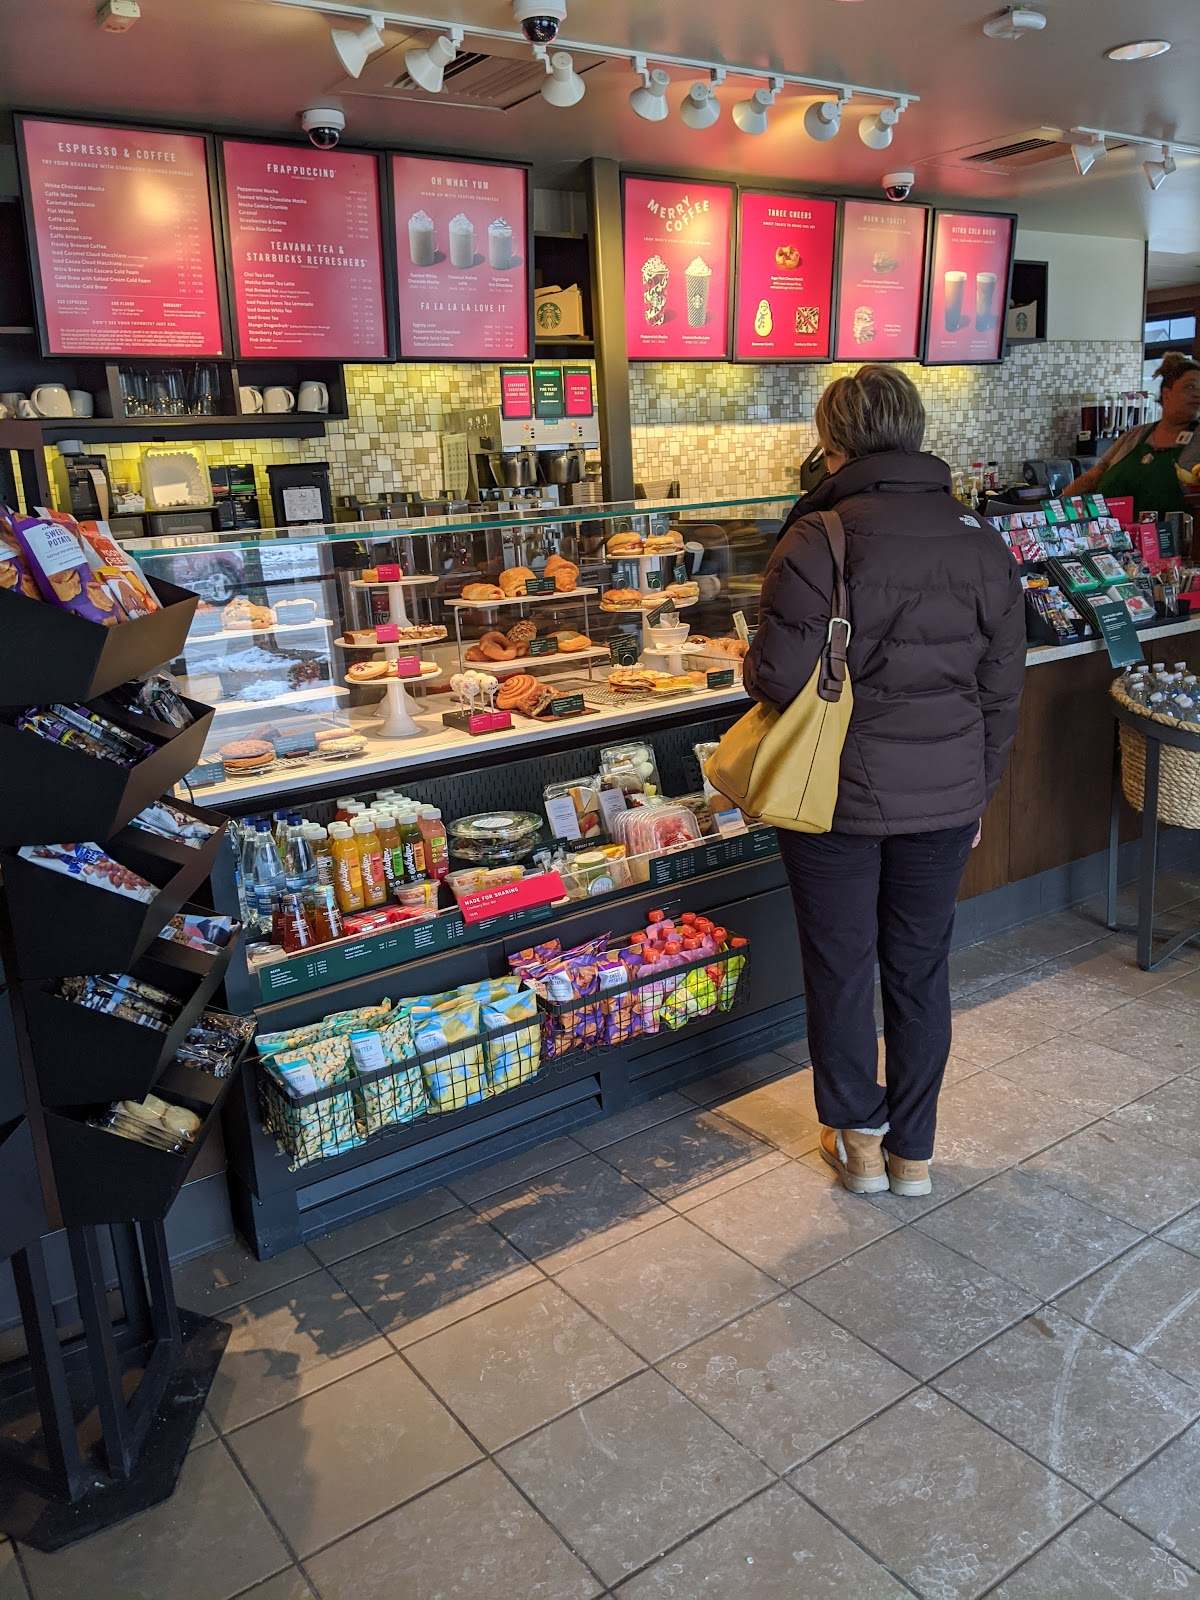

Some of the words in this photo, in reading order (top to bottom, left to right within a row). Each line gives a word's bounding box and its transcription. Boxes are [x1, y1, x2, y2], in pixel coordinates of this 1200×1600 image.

[58, 142, 117, 157] ESPRESSO
[123, 148, 130, 158] &
[136, 150, 177, 162] COFFEE
[267, 163, 336, 178] FRAPPUCCINO
[431, 176, 442, 185] OH
[446, 178, 468, 188] WHAT
[473, 180, 489, 189] YUM
[647, 195, 690, 219] MERRY
[768, 208, 787, 218] THREE
[789, 211, 811, 219] CHEERS
[665, 200, 709, 232] COFFEE
[983, 228, 996, 236] BREW
[270, 241, 312, 252] TEAVANA
[317, 244, 334, 253] TEA
[338, 246, 344, 254] &
[246, 252, 302, 264] STARBUCKS
[307, 256, 366, 268] REFRESHERS
[420, 302, 429, 310] FA
[434, 303, 444, 311] LA
[448, 303, 457, 311] LA
[461, 303, 471, 311] LA
[474, 304, 494, 312] LOVE
[498, 304, 505, 312] IT
[45, 528, 65, 539] SWEET
[47, 535, 72, 548] POTATO
[464, 897, 480, 906] MADE
[494, 887, 519, 898] SHARING
